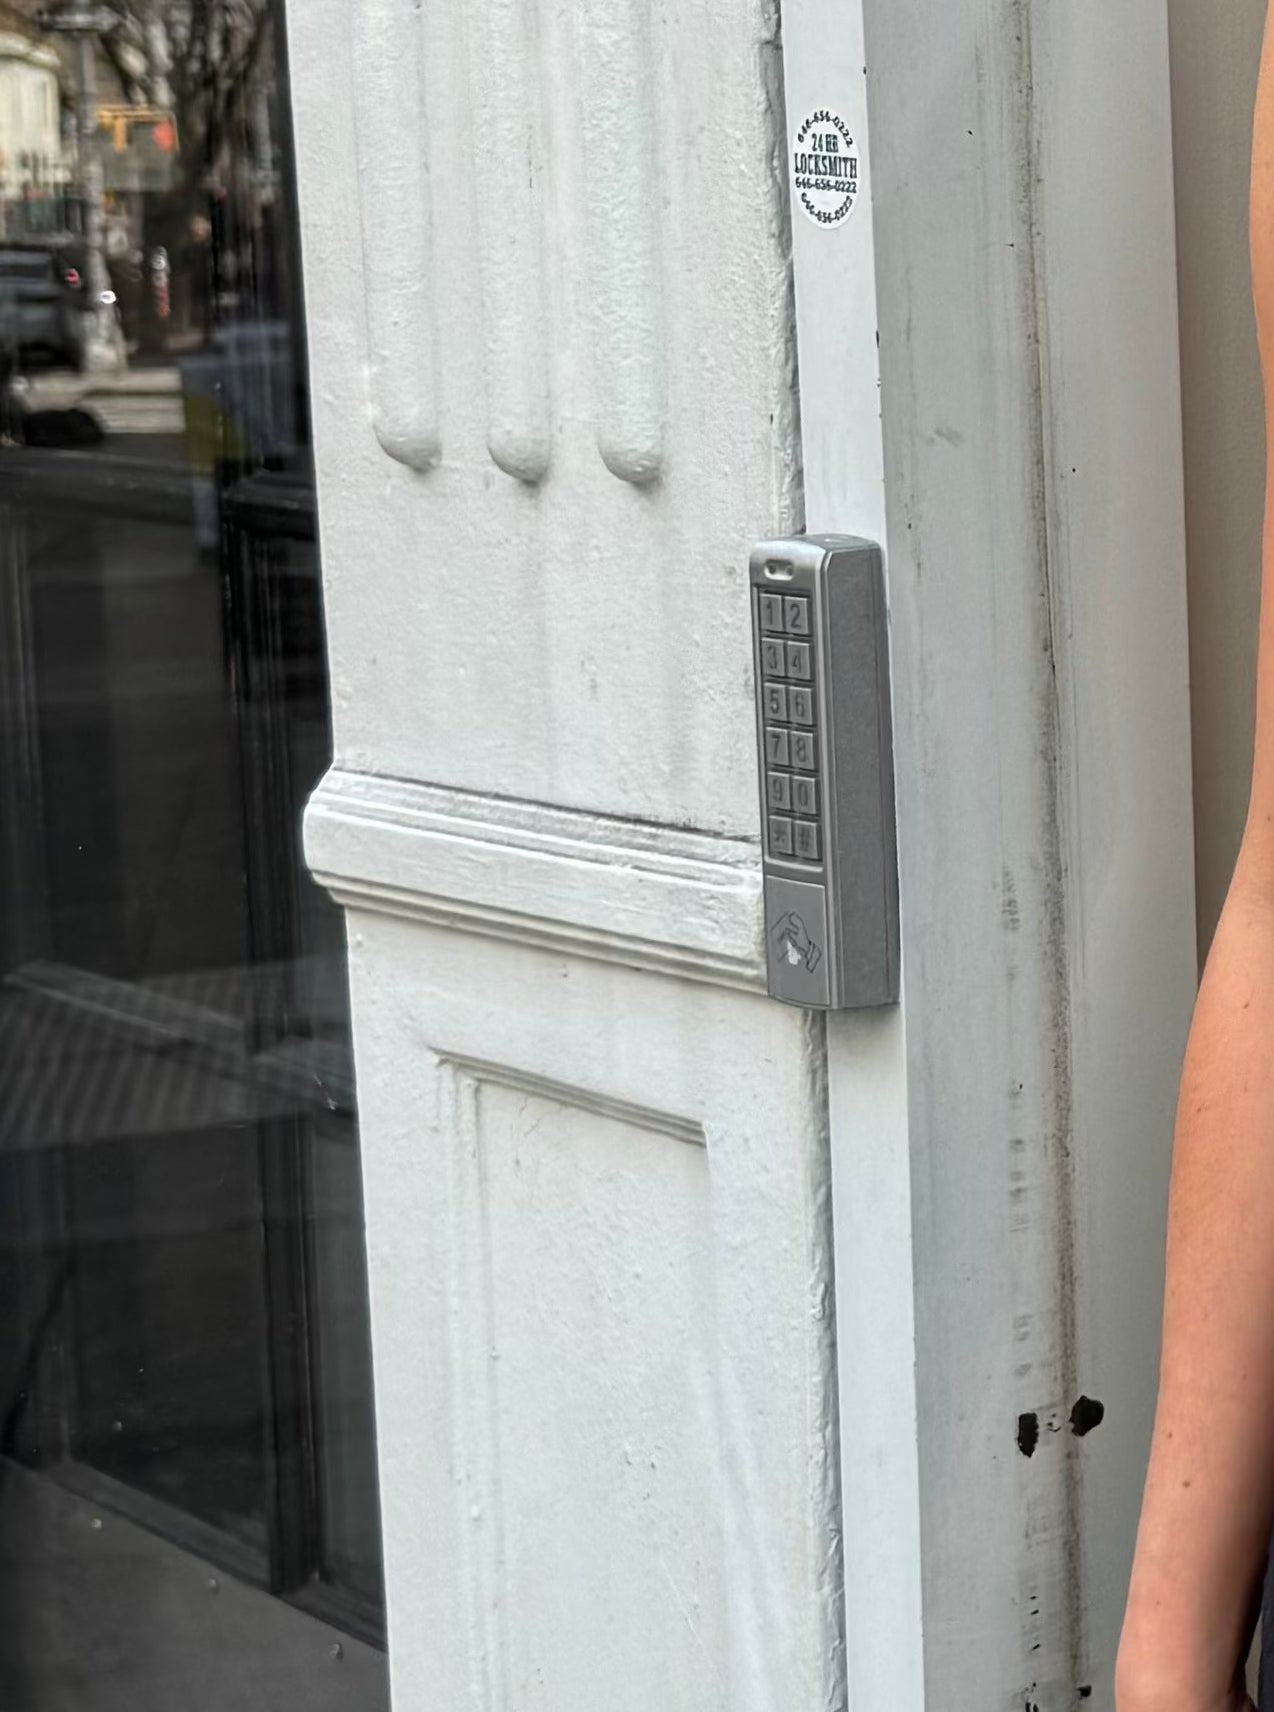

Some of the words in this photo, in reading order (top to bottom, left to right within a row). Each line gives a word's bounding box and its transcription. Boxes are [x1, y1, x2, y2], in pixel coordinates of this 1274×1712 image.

[811, 132, 823, 152] 24
[825, 133, 838, 153] HR
[794, 152, 857, 178] LOCKSMITH
